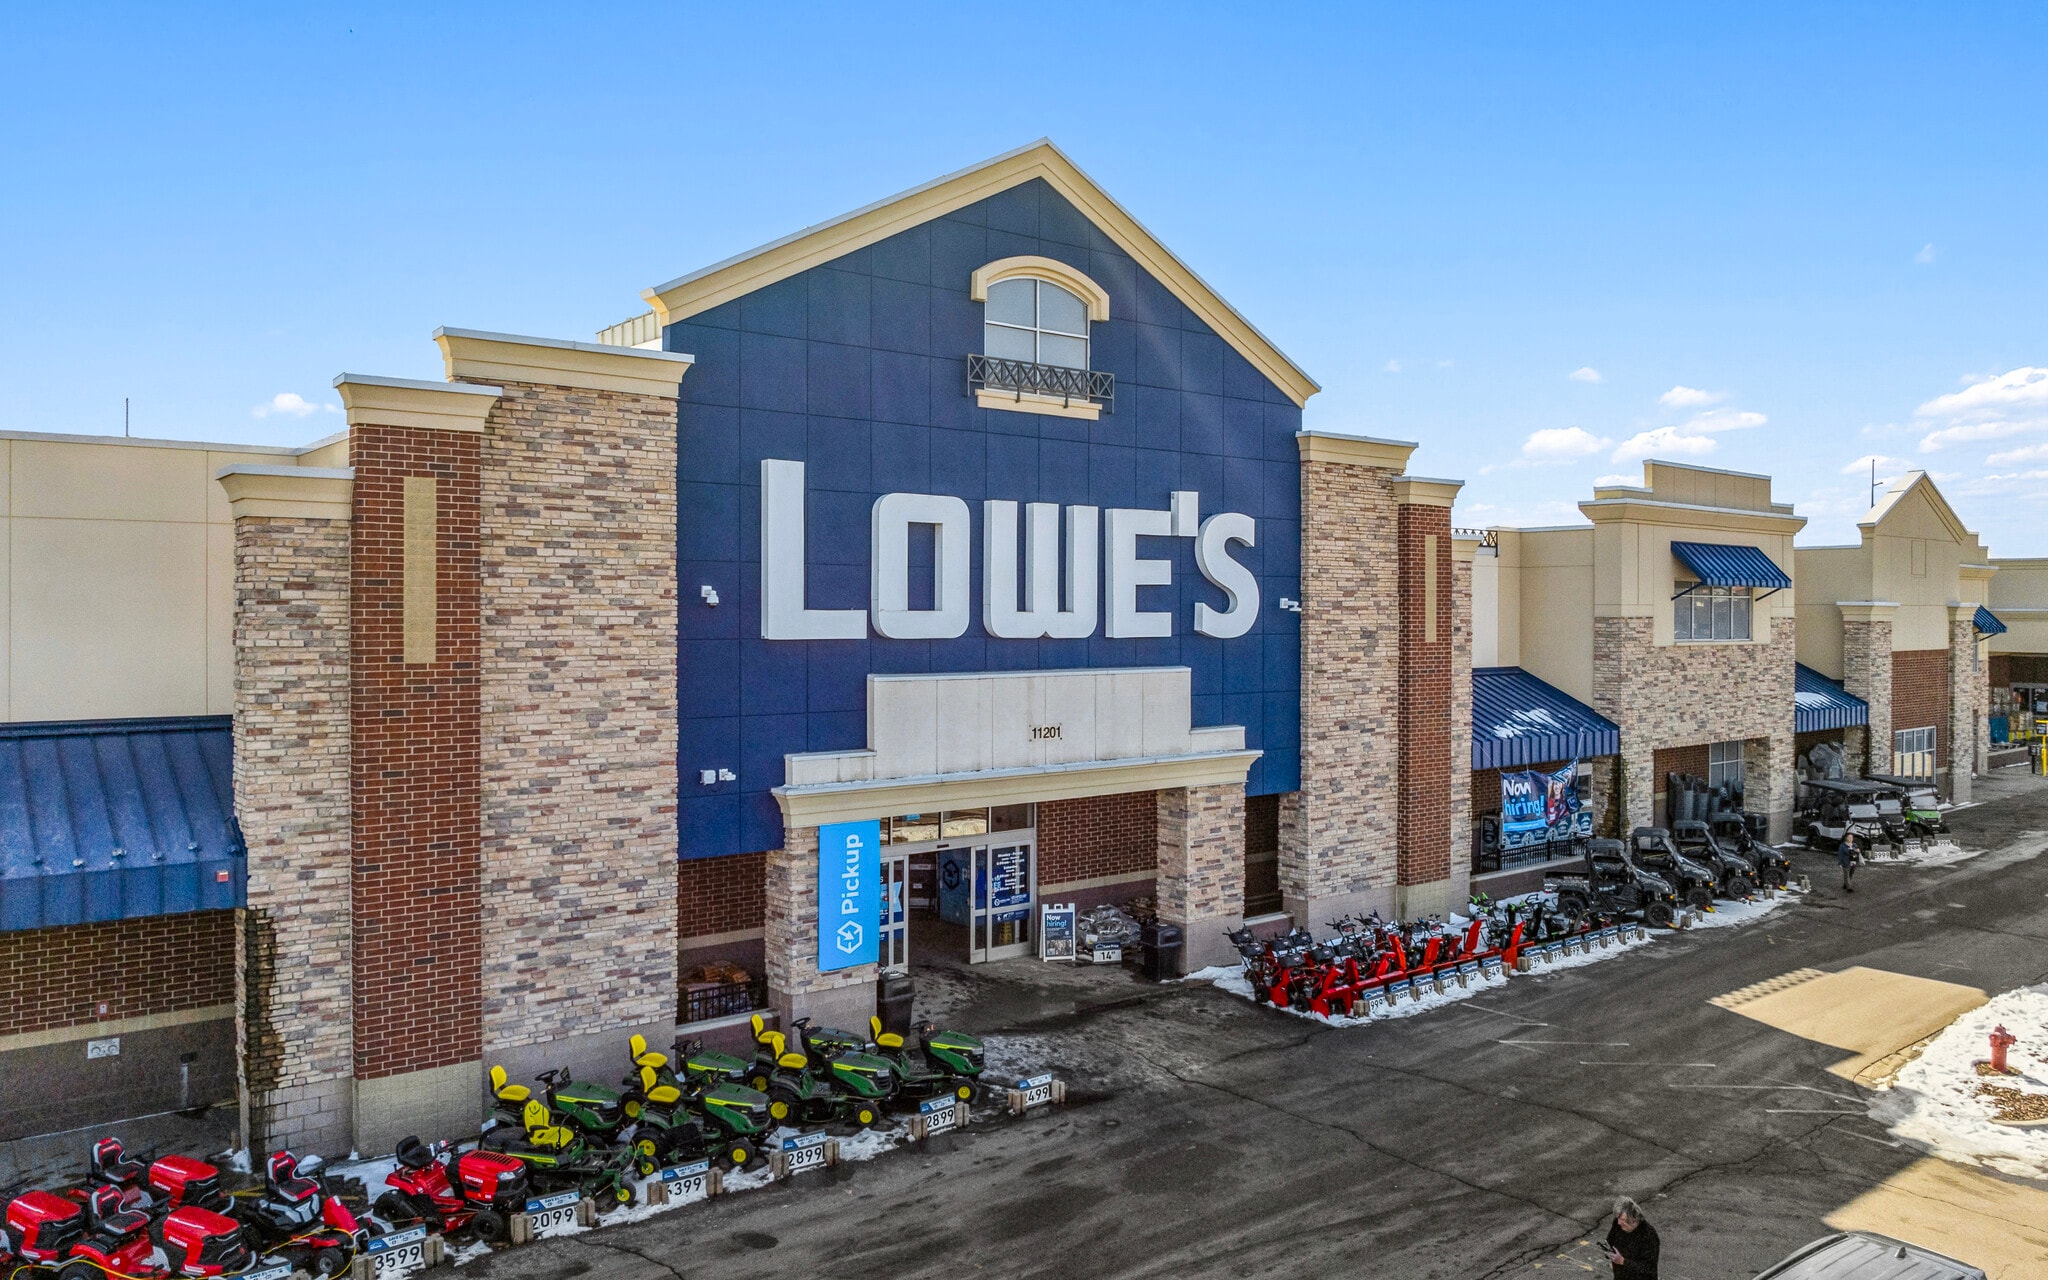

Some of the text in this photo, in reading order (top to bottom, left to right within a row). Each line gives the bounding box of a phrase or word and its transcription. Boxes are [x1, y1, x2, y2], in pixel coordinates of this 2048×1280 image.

[761, 458, 1260, 640] LOWE'S
[1031, 726, 1061, 739] 11201
[1504, 795, 1545, 816] hiring!
[841, 834, 864, 914] Pickup
[1046, 920, 1067, 928] hiring!
[1025, 1086, 1048, 1104] 499
[926, 1109, 954, 1128] 2899
[788, 1147, 822, 1167] 2899
[532, 1207, 574, 1230] 2099
[375, 1246, 421, 1271] 3599
